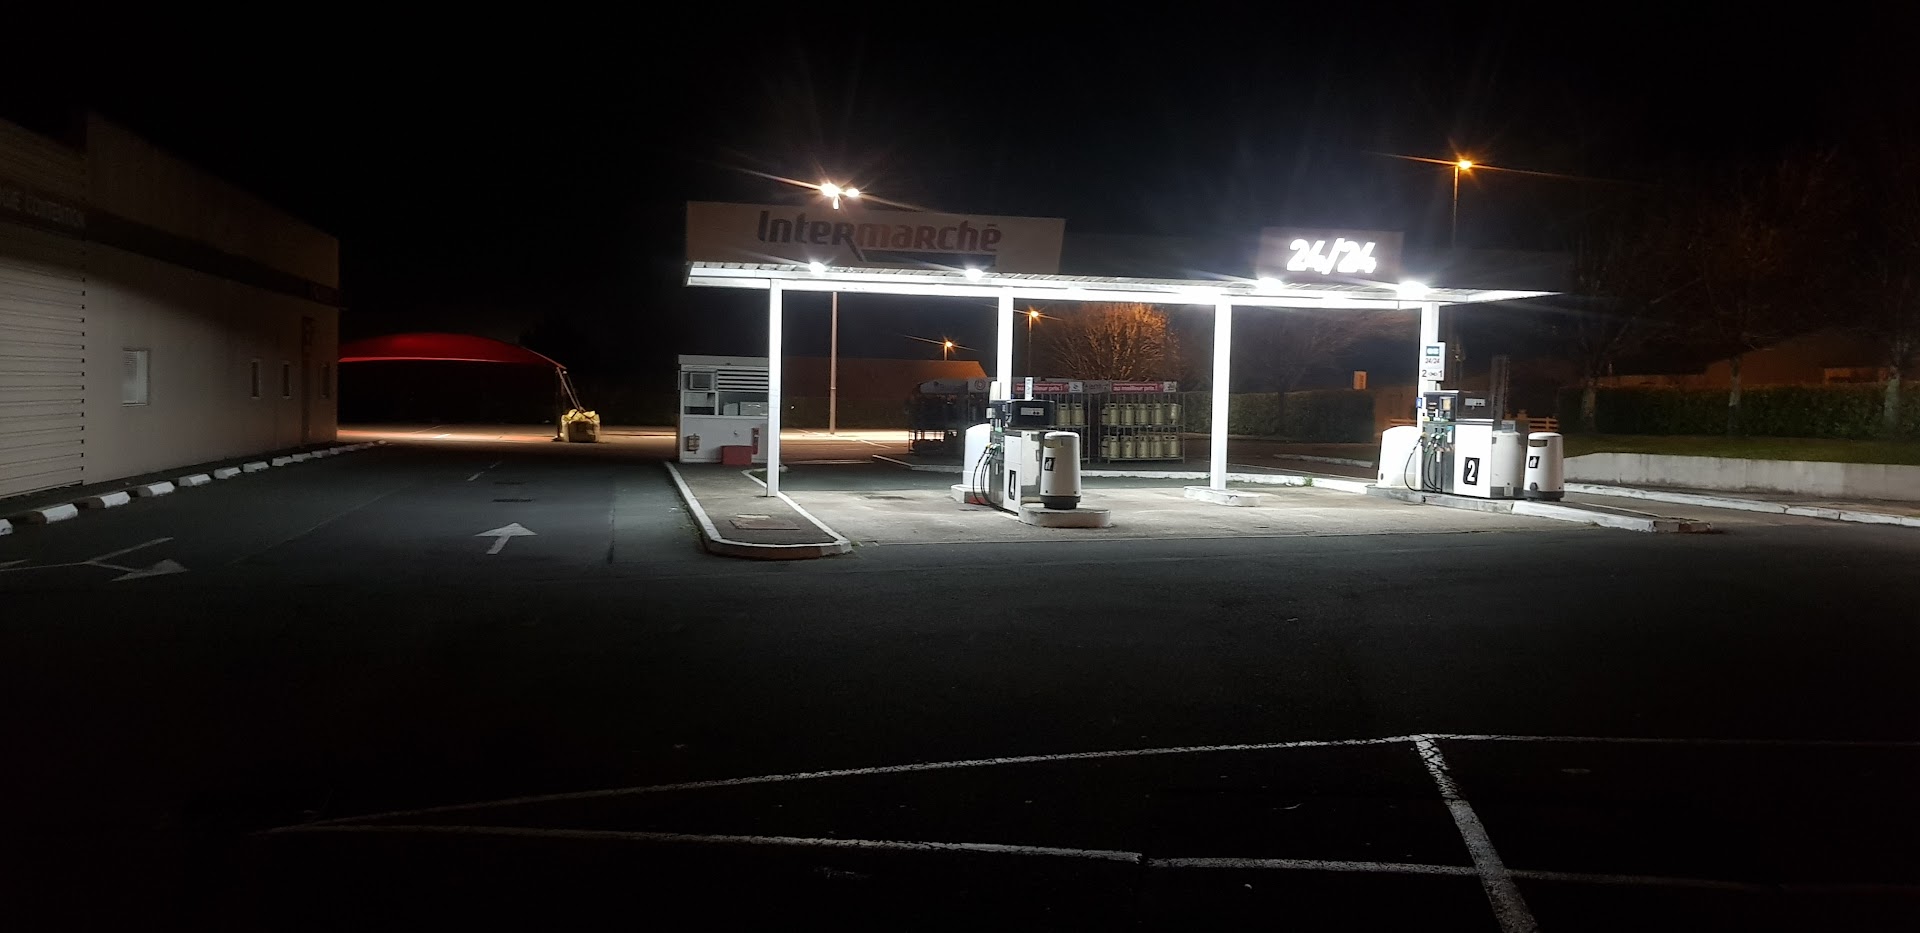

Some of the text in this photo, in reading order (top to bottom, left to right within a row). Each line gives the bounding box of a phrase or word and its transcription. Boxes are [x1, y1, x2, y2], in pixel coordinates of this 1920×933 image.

[757, 210, 1002, 262] Intermarché
[1286, 237, 1377, 275] 24/24
[1421, 369, 1443, 378] 2 1
[1467, 460, 1476, 482] 2
